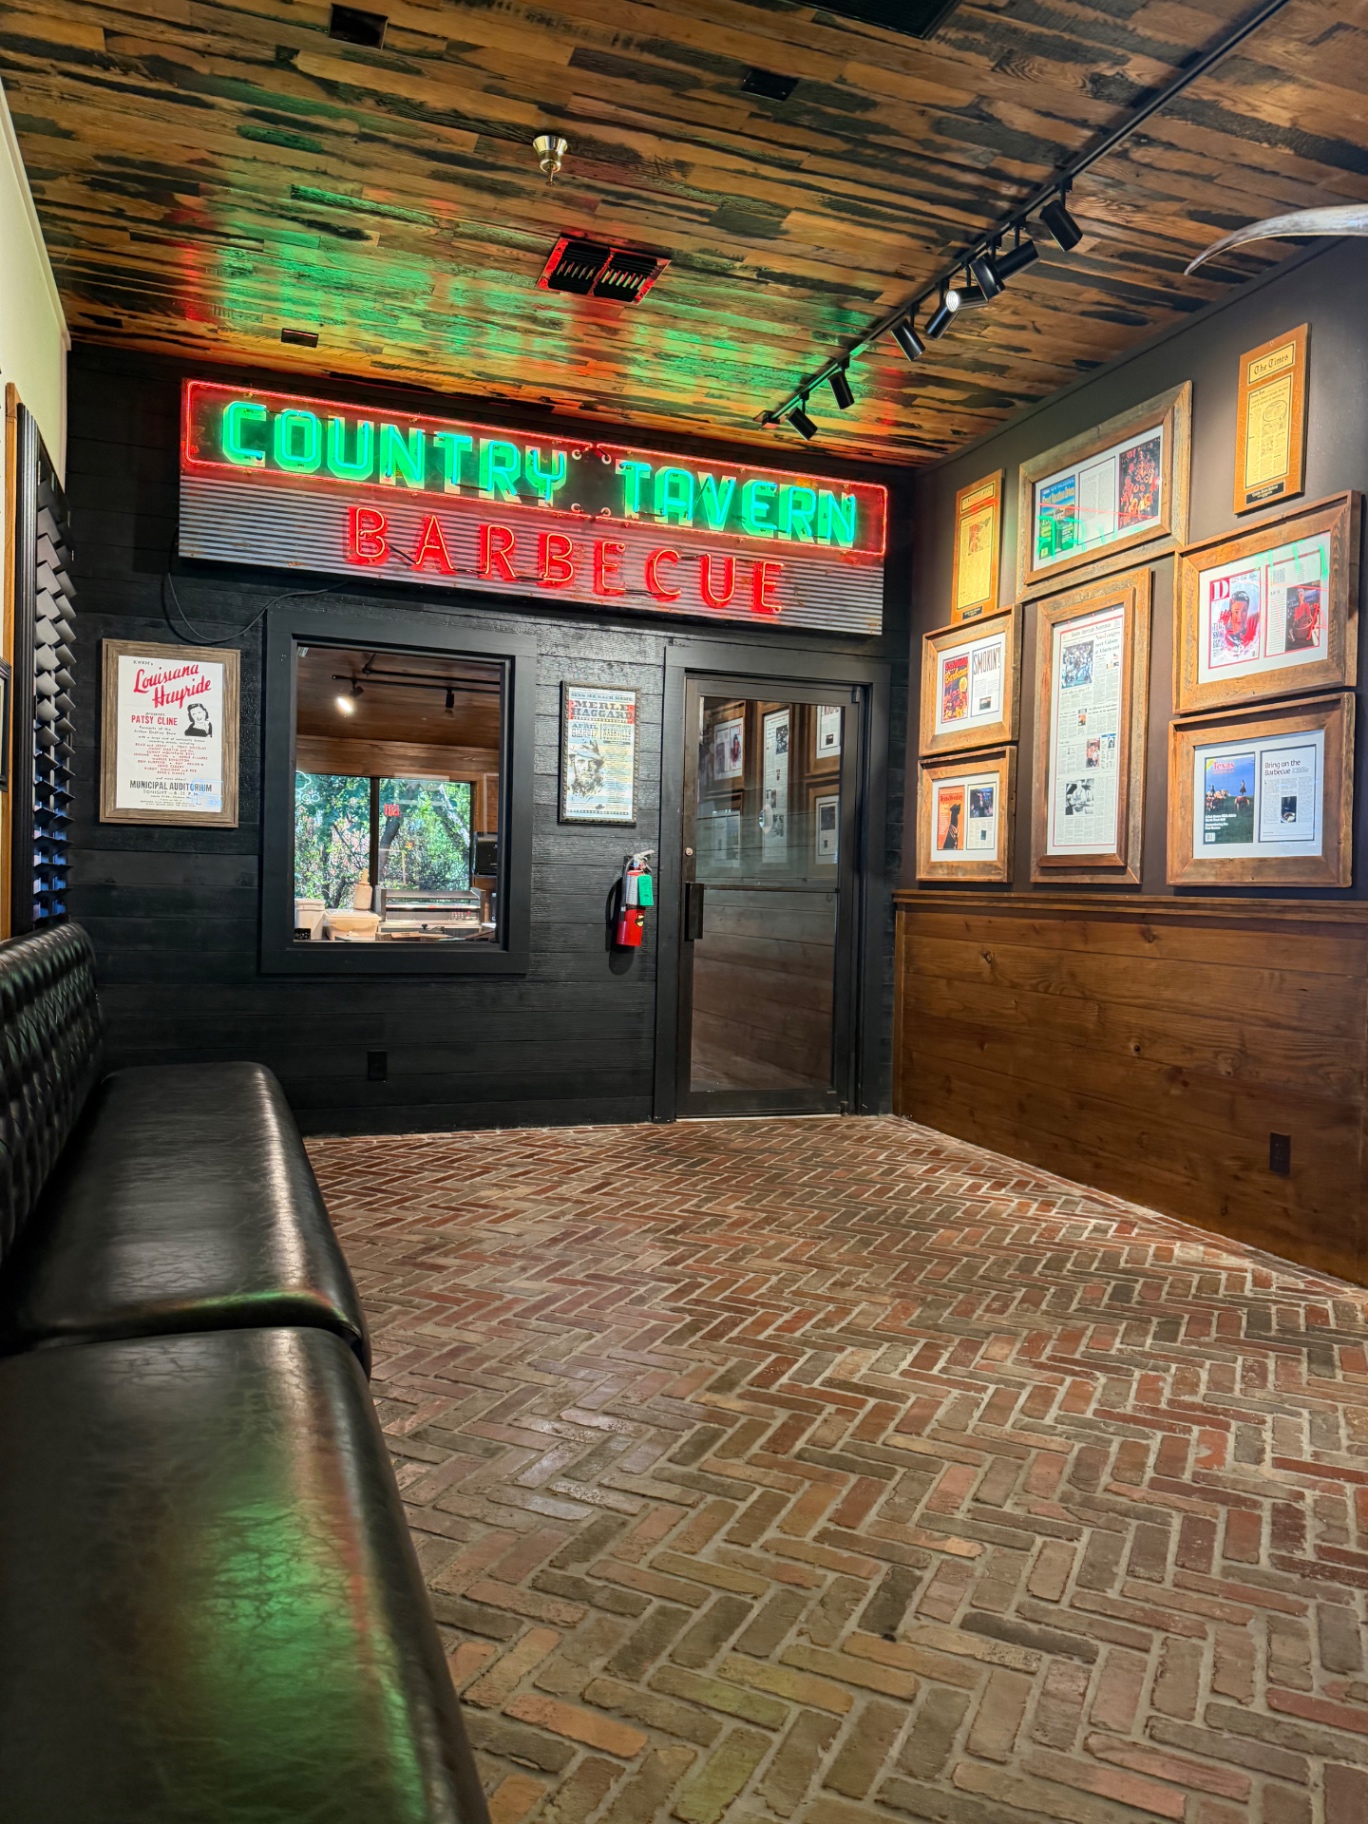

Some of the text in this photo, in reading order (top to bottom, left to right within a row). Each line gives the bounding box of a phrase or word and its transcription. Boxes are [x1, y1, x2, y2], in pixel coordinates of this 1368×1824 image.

[1254, 354, 1289, 375] The Times
[222, 401, 857, 548] COUNTRY TAVERN
[346, 506, 784, 615] BARBECUE
[1212, 580, 1229, 600] D
[133, 664, 199, 694] Louisiana
[152, 675, 211, 709] Hayride
[574, 700, 629, 711] MERLE
[571, 707, 633, 720] HAGGARD
[131, 715, 178, 726] PATSY CLINE
[1213, 761, 1234, 770] Texas
[1264, 762, 1280, 770] Bring
[1264, 768, 1291, 776] Barbecue
[129, 780, 212, 792] MUNICIPAL AUDITORIUM
